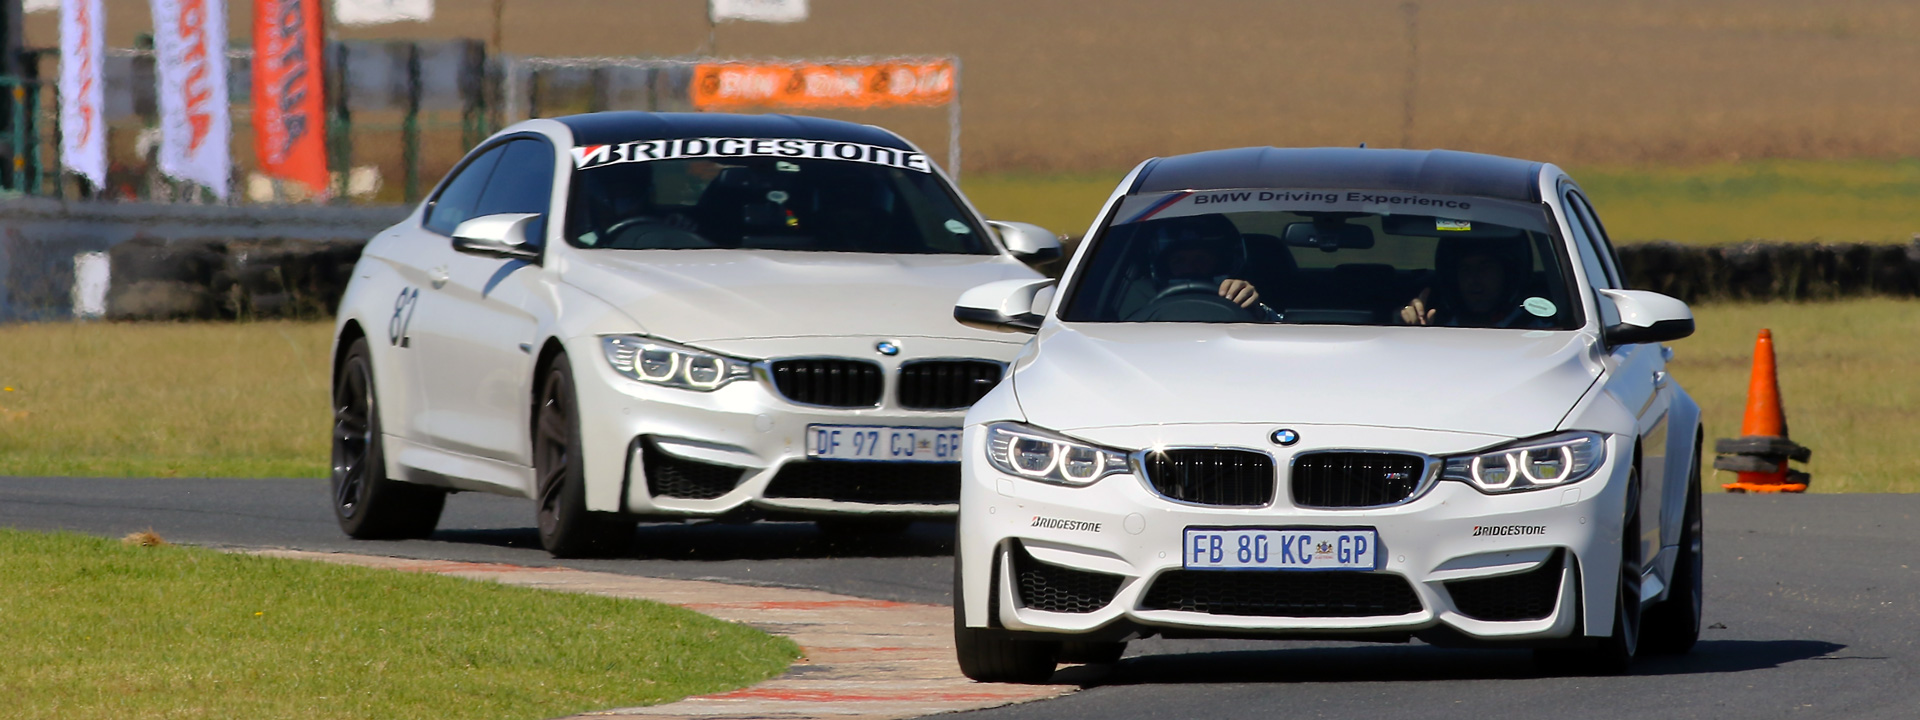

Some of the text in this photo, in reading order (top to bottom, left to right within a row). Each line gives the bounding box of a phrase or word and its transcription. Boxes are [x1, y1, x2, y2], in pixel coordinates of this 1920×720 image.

[577, 138, 927, 172] BRIDGESTONE
[1194, 191, 1471, 210] BMW Driving Experience
[389, 286, 418, 348] 82
[817, 430, 960, 457] DF 97 CJ GP
[1031, 516, 1102, 532] BRIDGESTONE
[1472, 525, 1546, 536] BRIDGESTONE
[1193, 535, 1367, 564] FB 80 KC GP
